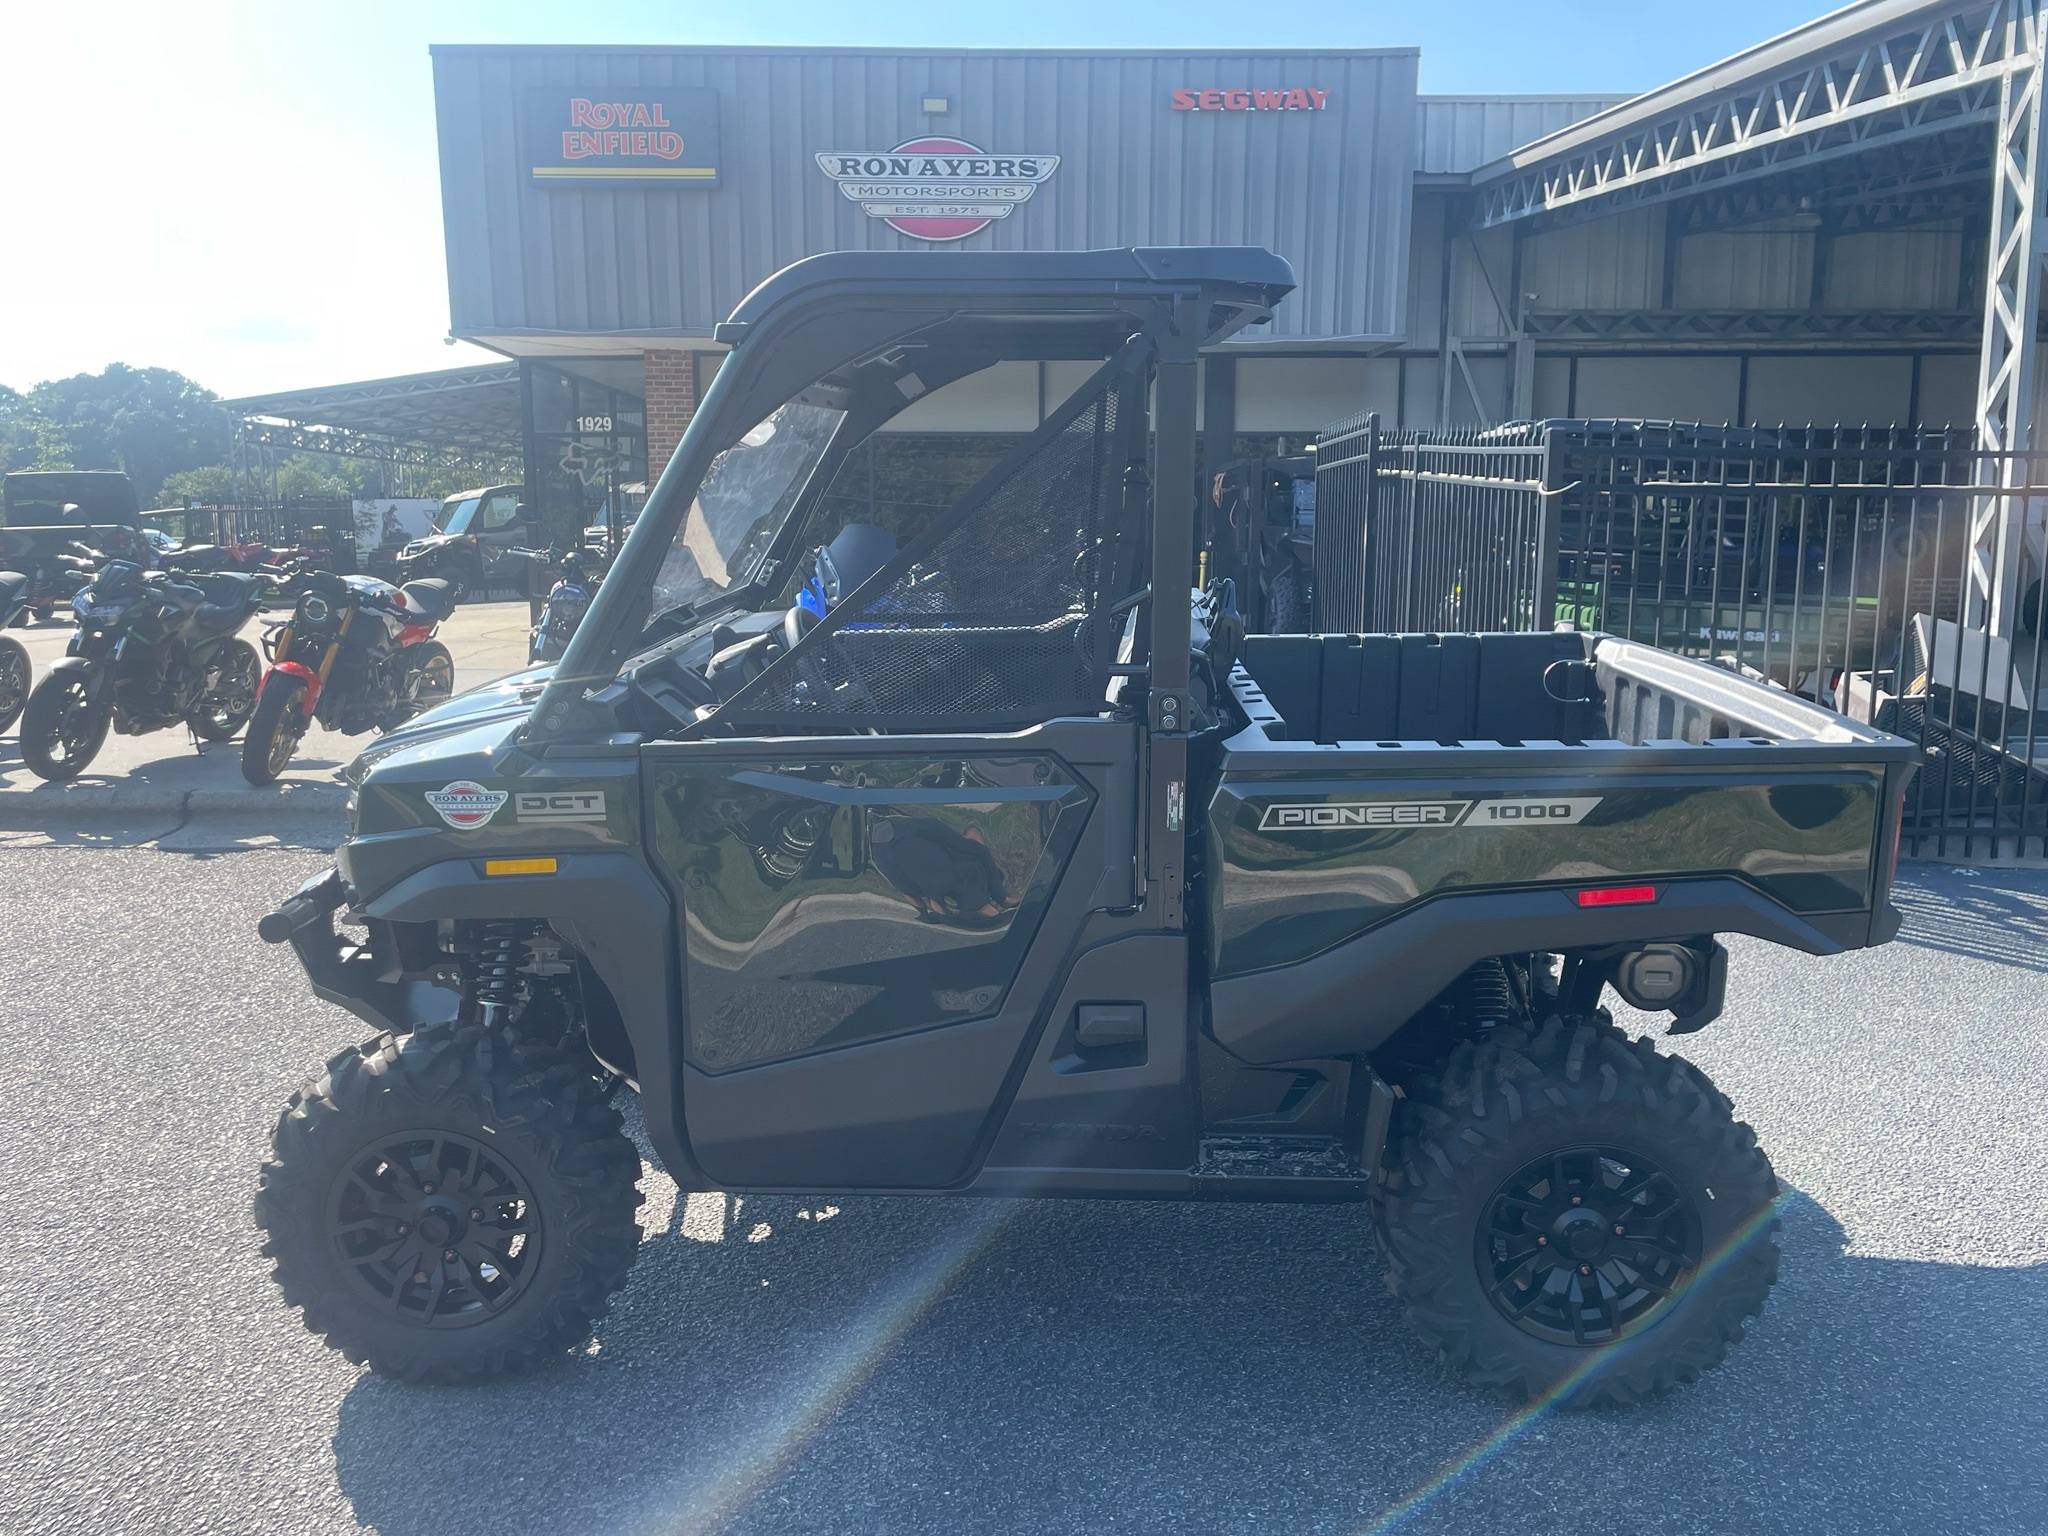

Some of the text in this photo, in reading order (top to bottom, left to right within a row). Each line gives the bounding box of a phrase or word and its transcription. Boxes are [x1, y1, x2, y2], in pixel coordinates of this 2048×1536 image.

[1171, 88, 1331, 110] SEGWAY
[570, 98, 670, 130] ROYAL
[562, 131, 684, 160] ENFIELD
[837, 157, 1039, 178] RON AYERS
[858, 186, 1016, 197] MOTORSPORTS
[895, 206, 980, 214] EST. 1975
[576, 416, 612, 432] 1929
[521, 795, 598, 810] DCT
[1277, 804, 1571, 825] PIONEER 1000
[1018, 1122, 1167, 1141] HONDA
